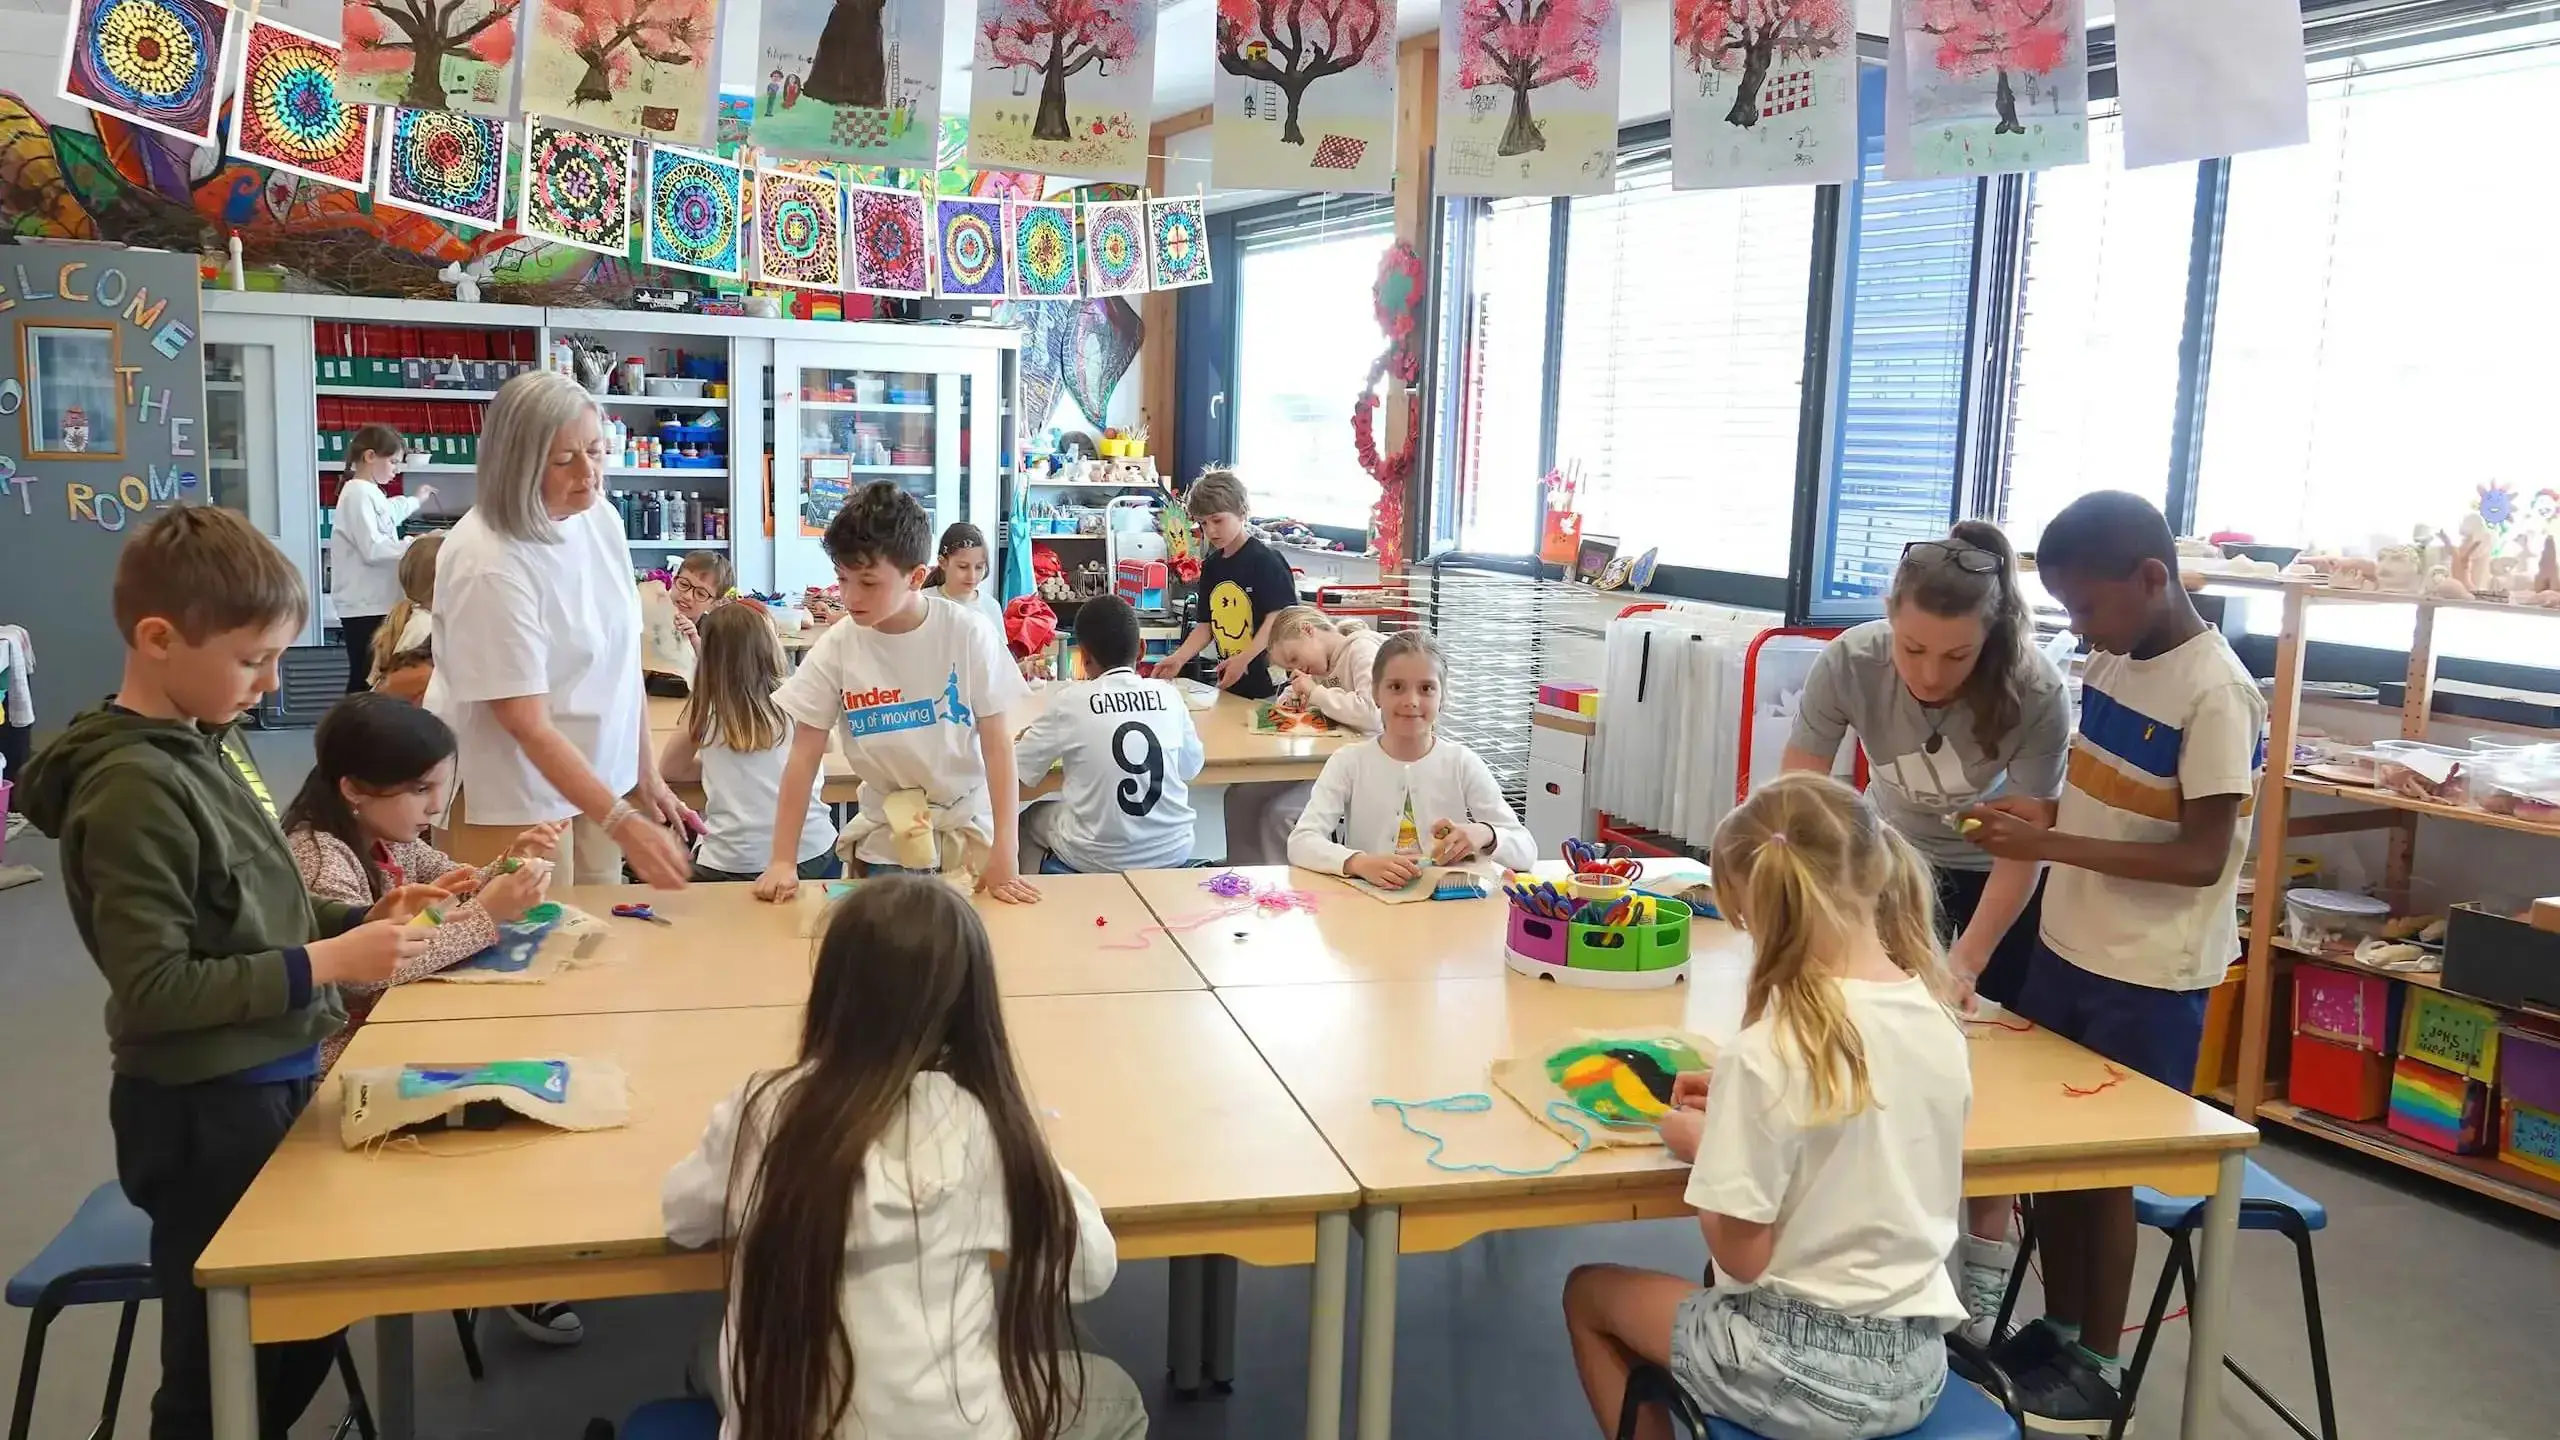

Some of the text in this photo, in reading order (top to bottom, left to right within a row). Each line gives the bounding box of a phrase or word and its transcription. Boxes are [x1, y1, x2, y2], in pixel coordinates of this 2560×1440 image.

[114, 366, 196, 456] THE
[67, 464, 180, 532] ROOM
[867, 712, 879, 728] of
[881, 707, 931, 726] moving
[1089, 690, 1167, 715] GABRIEL
[1110, 720, 1164, 817] 9
